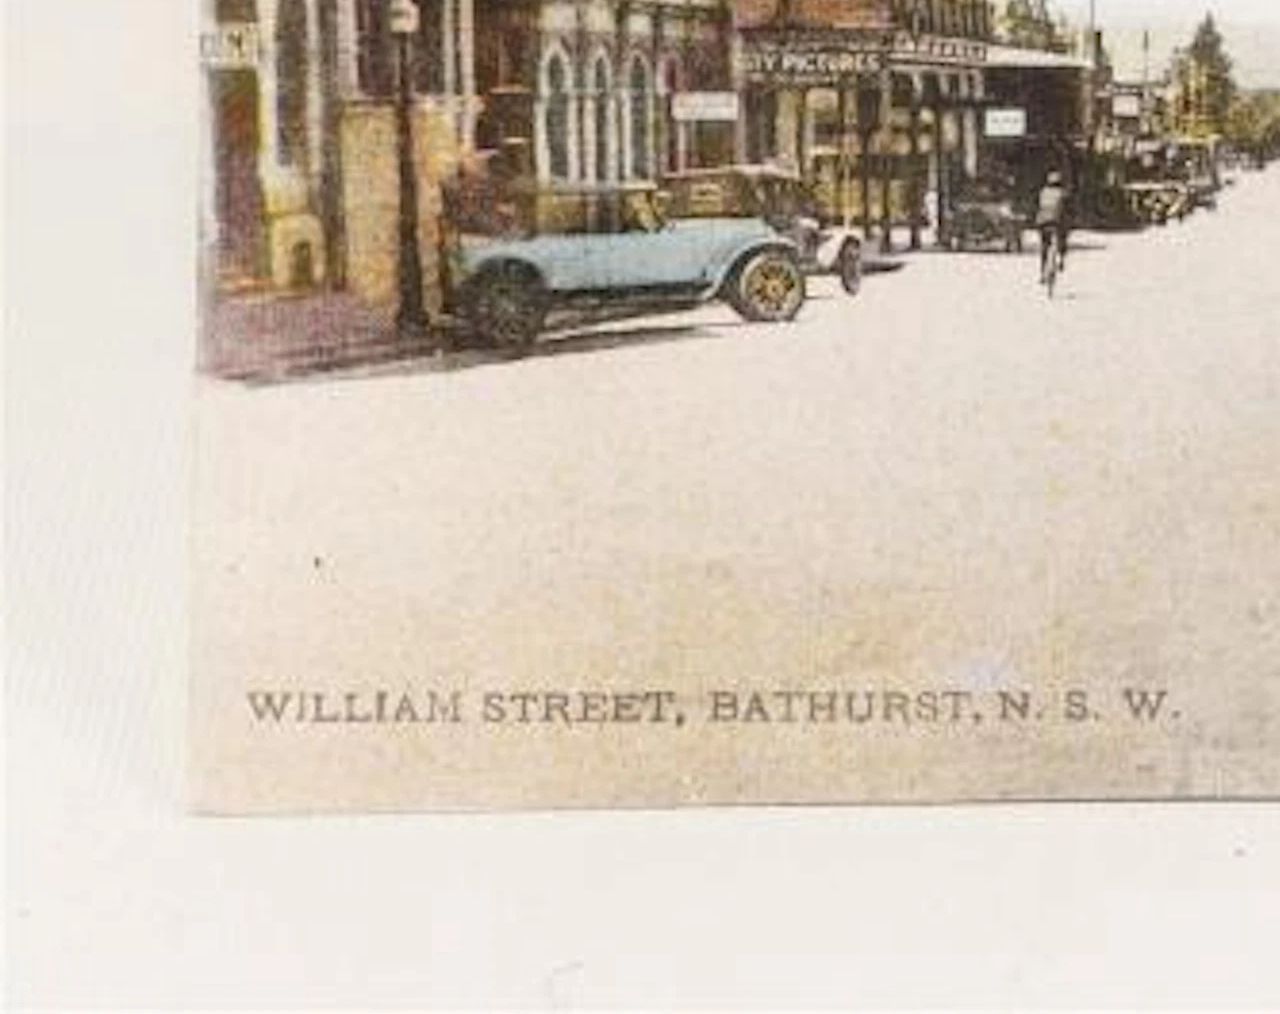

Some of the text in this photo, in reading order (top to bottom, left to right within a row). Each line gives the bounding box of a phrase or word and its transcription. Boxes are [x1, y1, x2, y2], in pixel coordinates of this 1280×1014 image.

[247, 689, 1182, 727] WILLIAM STREET, BATHURST, N. S. W.
